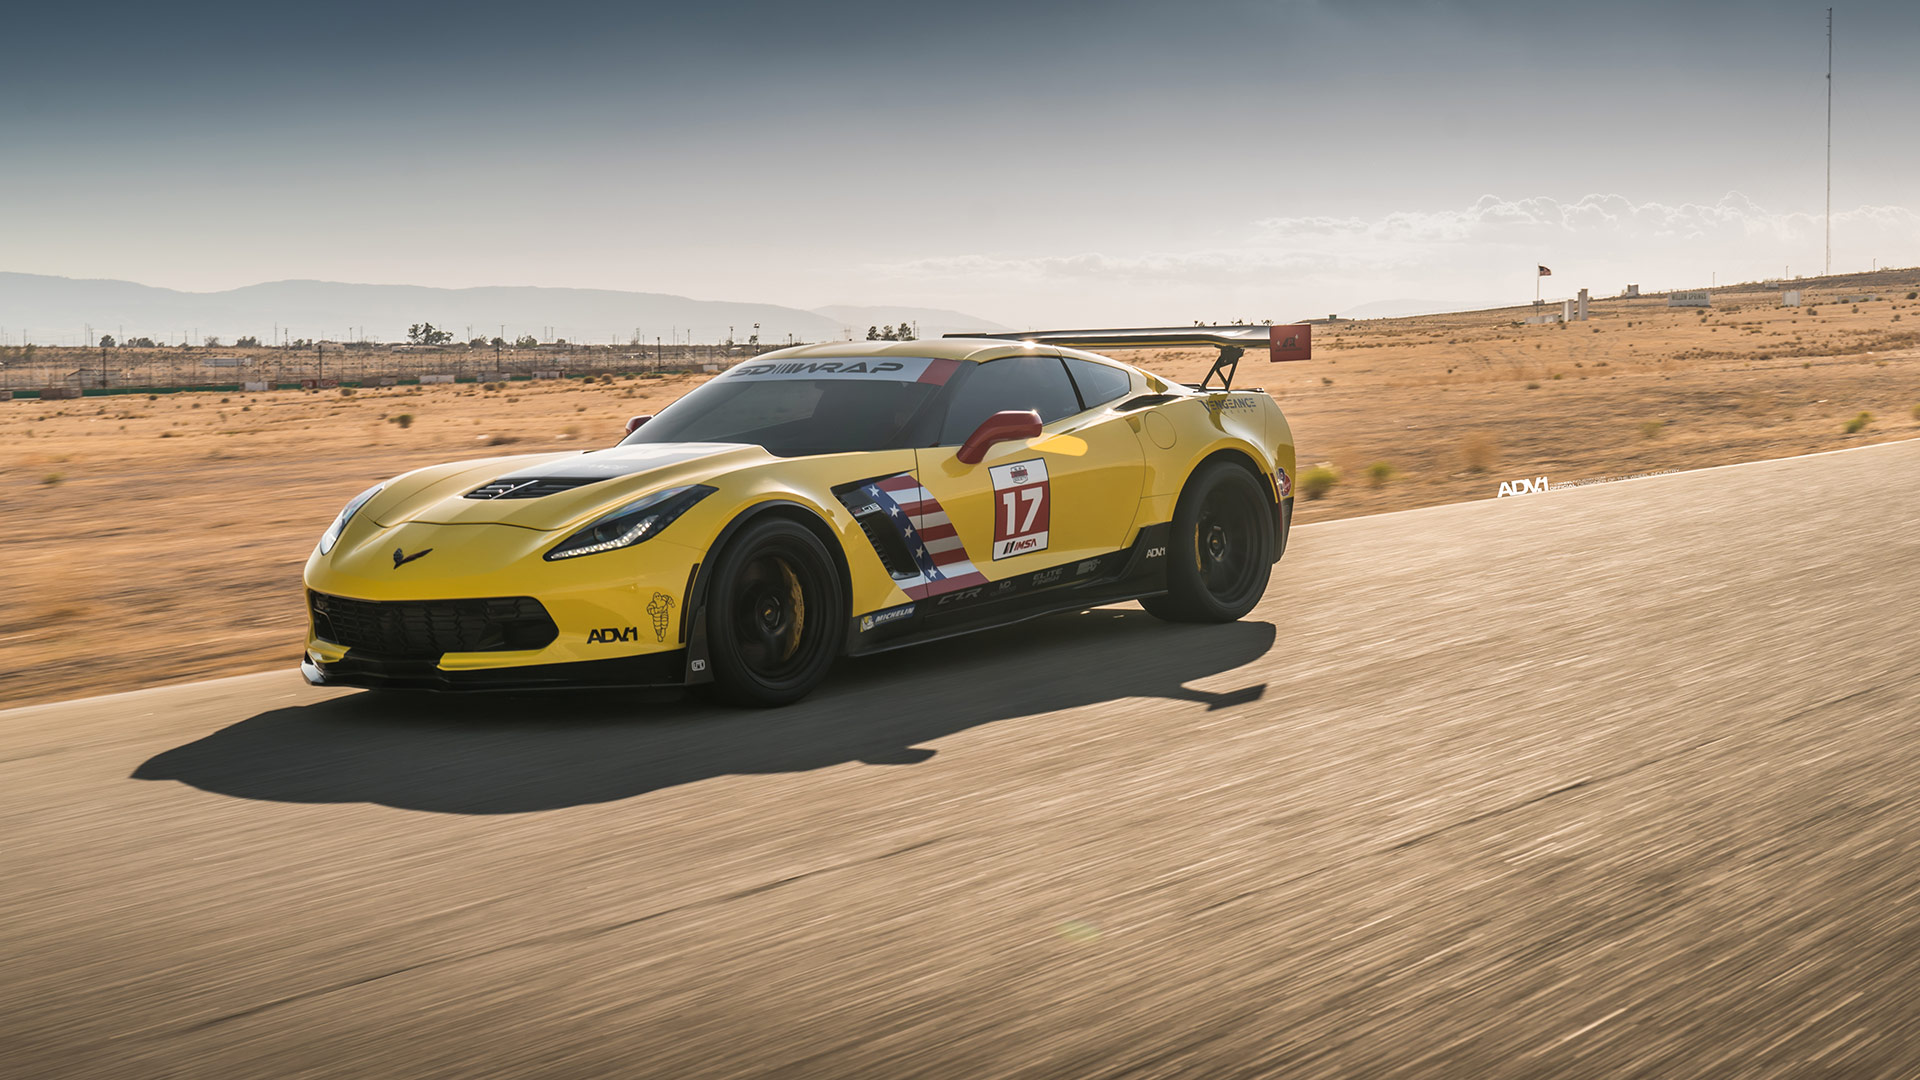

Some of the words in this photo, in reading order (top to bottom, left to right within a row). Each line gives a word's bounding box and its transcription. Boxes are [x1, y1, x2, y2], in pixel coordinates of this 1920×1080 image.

[1197, 397, 1257, 414] VENGEANCE
[1003, 486, 1043, 536] 17
[1013, 538, 1037, 551] IMSA
[875, 606, 915, 623] MICHELIN
